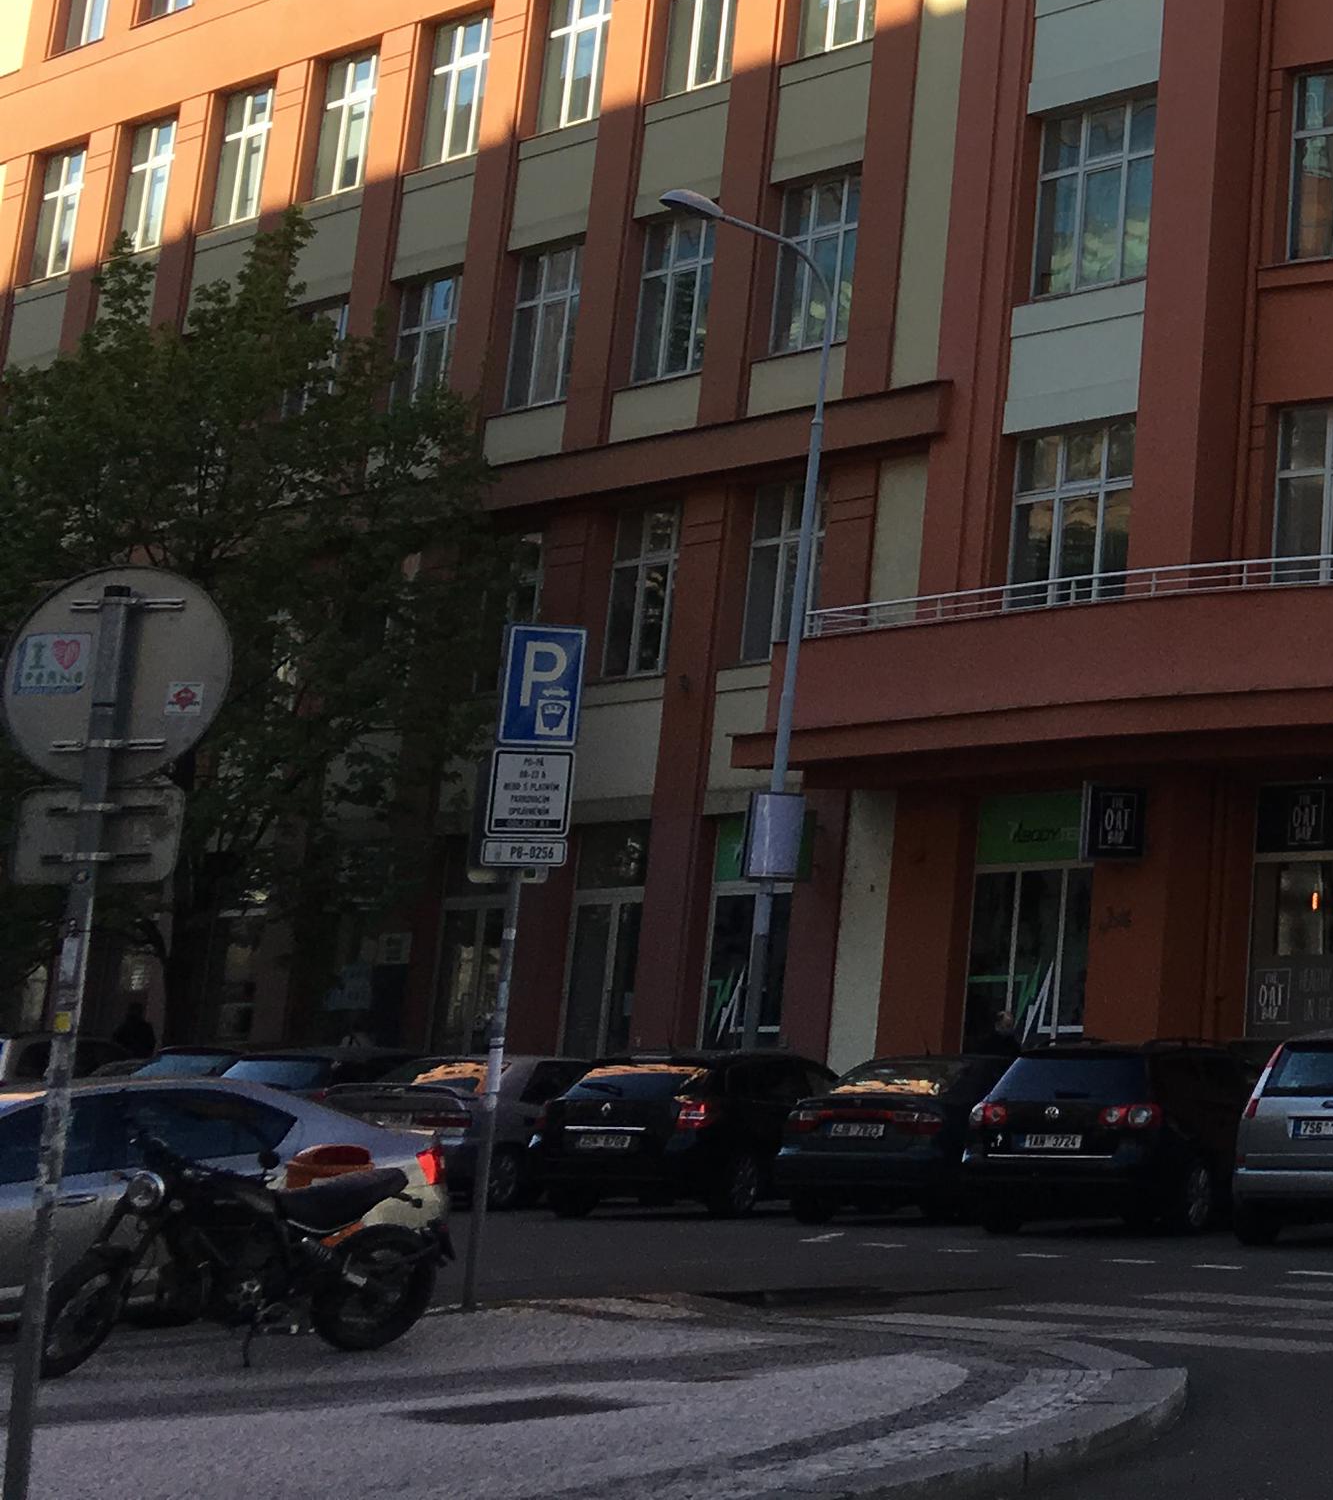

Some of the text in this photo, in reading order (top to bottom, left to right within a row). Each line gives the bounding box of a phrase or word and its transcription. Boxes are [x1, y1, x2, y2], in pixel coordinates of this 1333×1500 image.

[519, 640, 568, 707] P
[1104, 808, 1131, 831] OAT
[1291, 804, 1319, 828] OAT
[509, 846, 555, 859] P8-0256
[1257, 983, 1285, 1008] OAT
